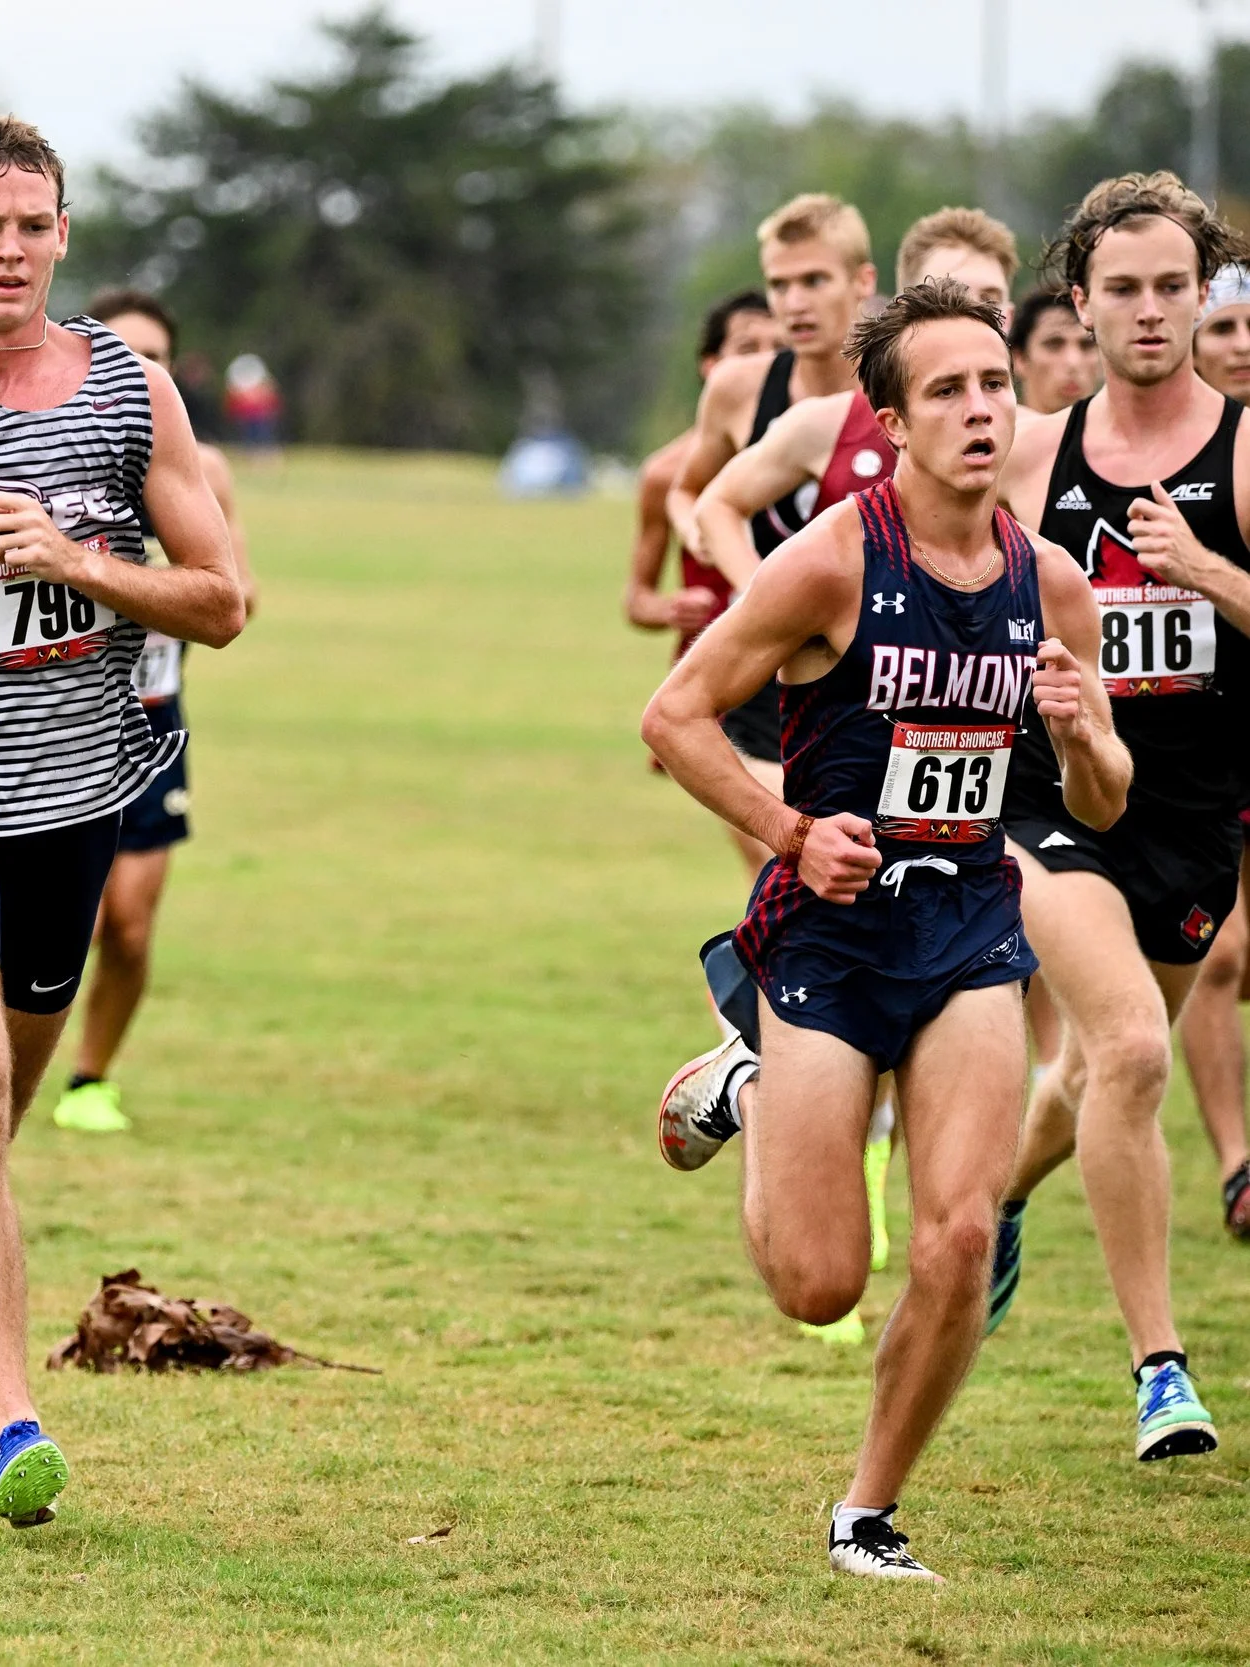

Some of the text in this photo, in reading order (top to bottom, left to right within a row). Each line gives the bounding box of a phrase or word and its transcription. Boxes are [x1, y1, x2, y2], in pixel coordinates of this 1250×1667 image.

[1055, 500, 1092, 510] adidas
[1170, 483, 1216, 500] ACC
[4, 579, 96, 646] 798
[1093, 587, 1143, 603] OUTHERN
[1101, 609, 1193, 674] 816
[865, 644, 1038, 719] BELMONT
[904, 730, 1007, 748] SOUTHERN SHOWCASE
[907, 755, 992, 814] 613
